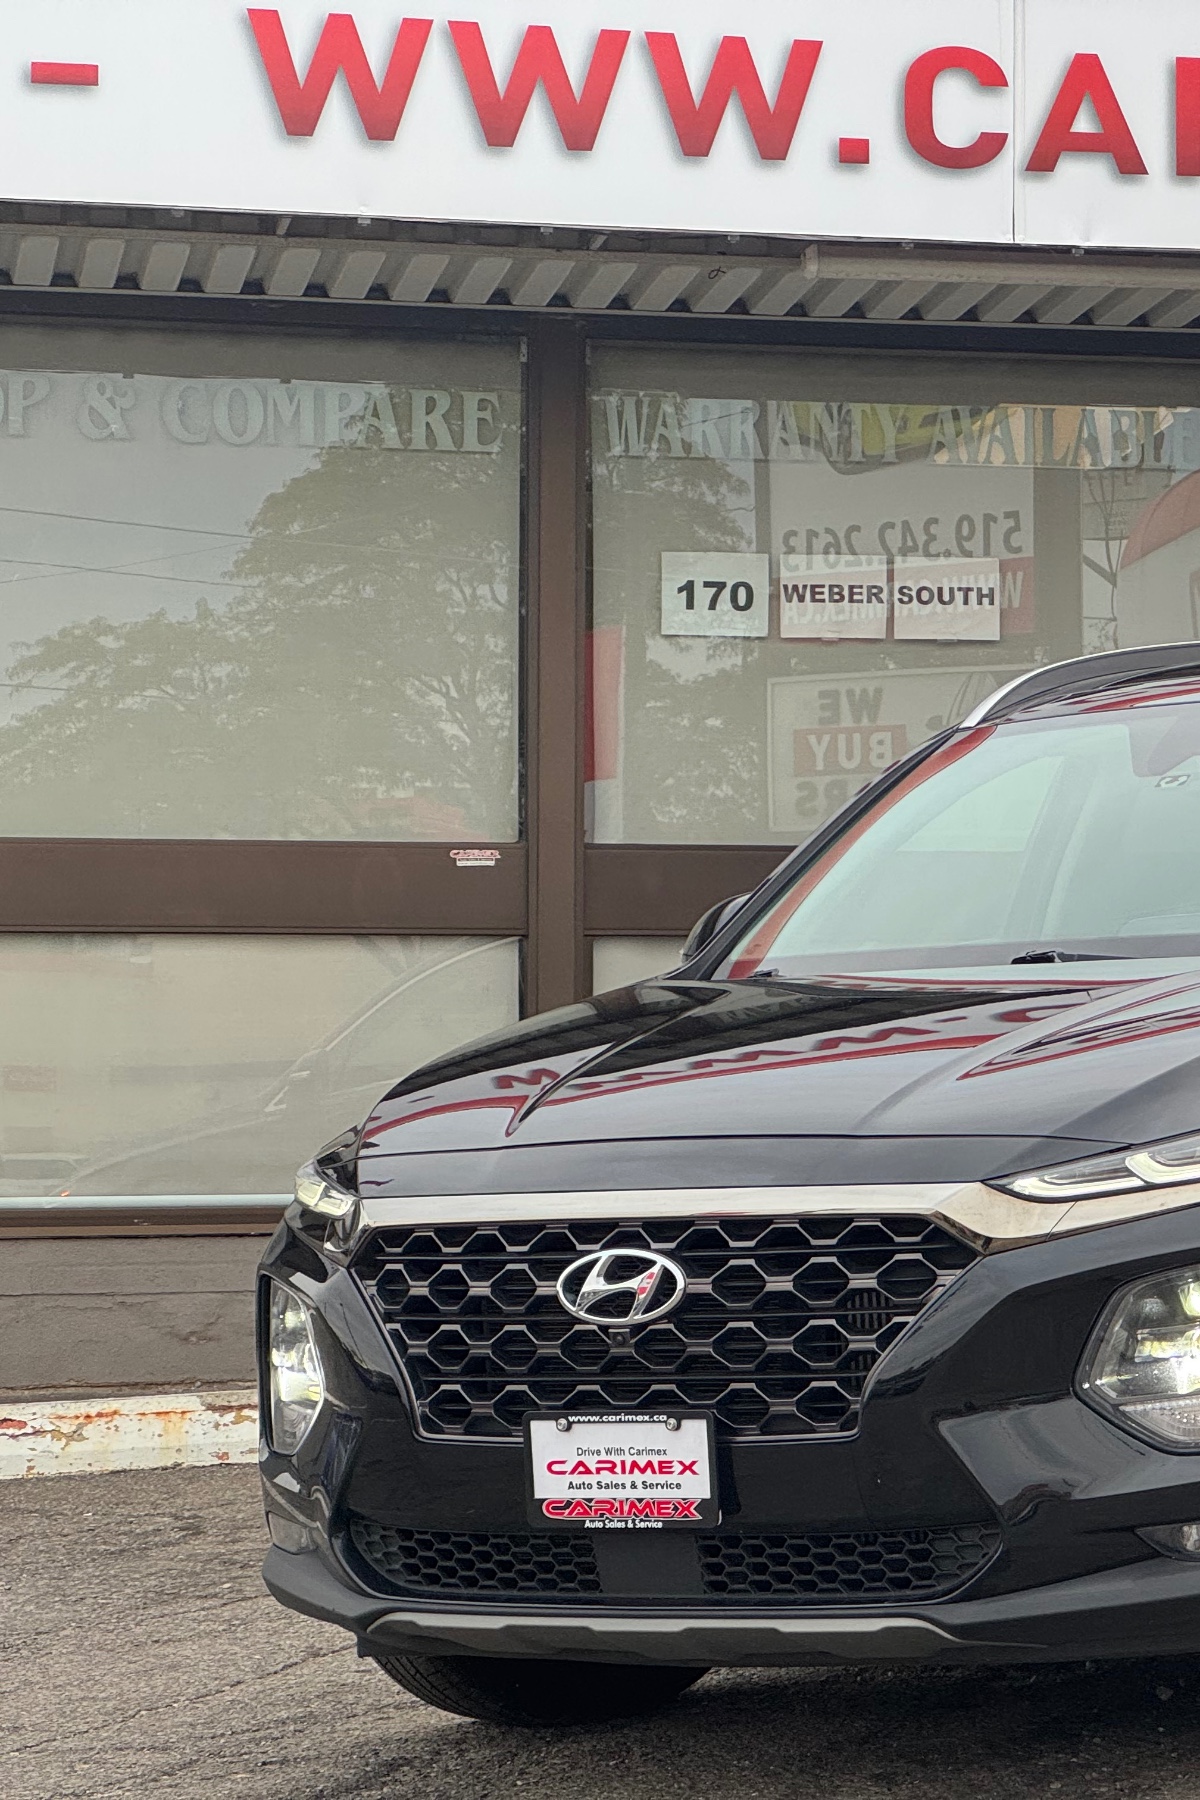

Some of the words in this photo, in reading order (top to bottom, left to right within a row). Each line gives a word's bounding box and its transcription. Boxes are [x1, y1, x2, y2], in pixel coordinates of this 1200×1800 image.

[76, 375, 136, 441] &
[161, 380, 501, 453] COMPARE
[600, 396, 904, 464] WARRANTY
[926, 404, 1199, 470] AVAILABLE
[676, 569, 755, 612] 170
[781, 583, 885, 605] WEBER
[896, 585, 996, 607] SOUTH
[567, 1412, 668, 1422] www.carimex.ca
[576, 1446, 602, 1457] Drive
[603, 1446, 626, 1457] With
[628, 1446, 668, 1457] Carimex
[546, 1459, 700, 1476] CARIMEX
[567, 1480, 593, 1491] Auto
[596, 1480, 627, 1491] Sales
[629, 1480, 639, 1490] &
[641, 1480, 682, 1491] Service
[543, 1498, 703, 1519] CARIMEX
[584, 1519, 604, 1529] Auto
[604, 1519, 626, 1529] Sales
[626, 1519, 634, 1529] &
[635, 1519, 663, 1529] Service
